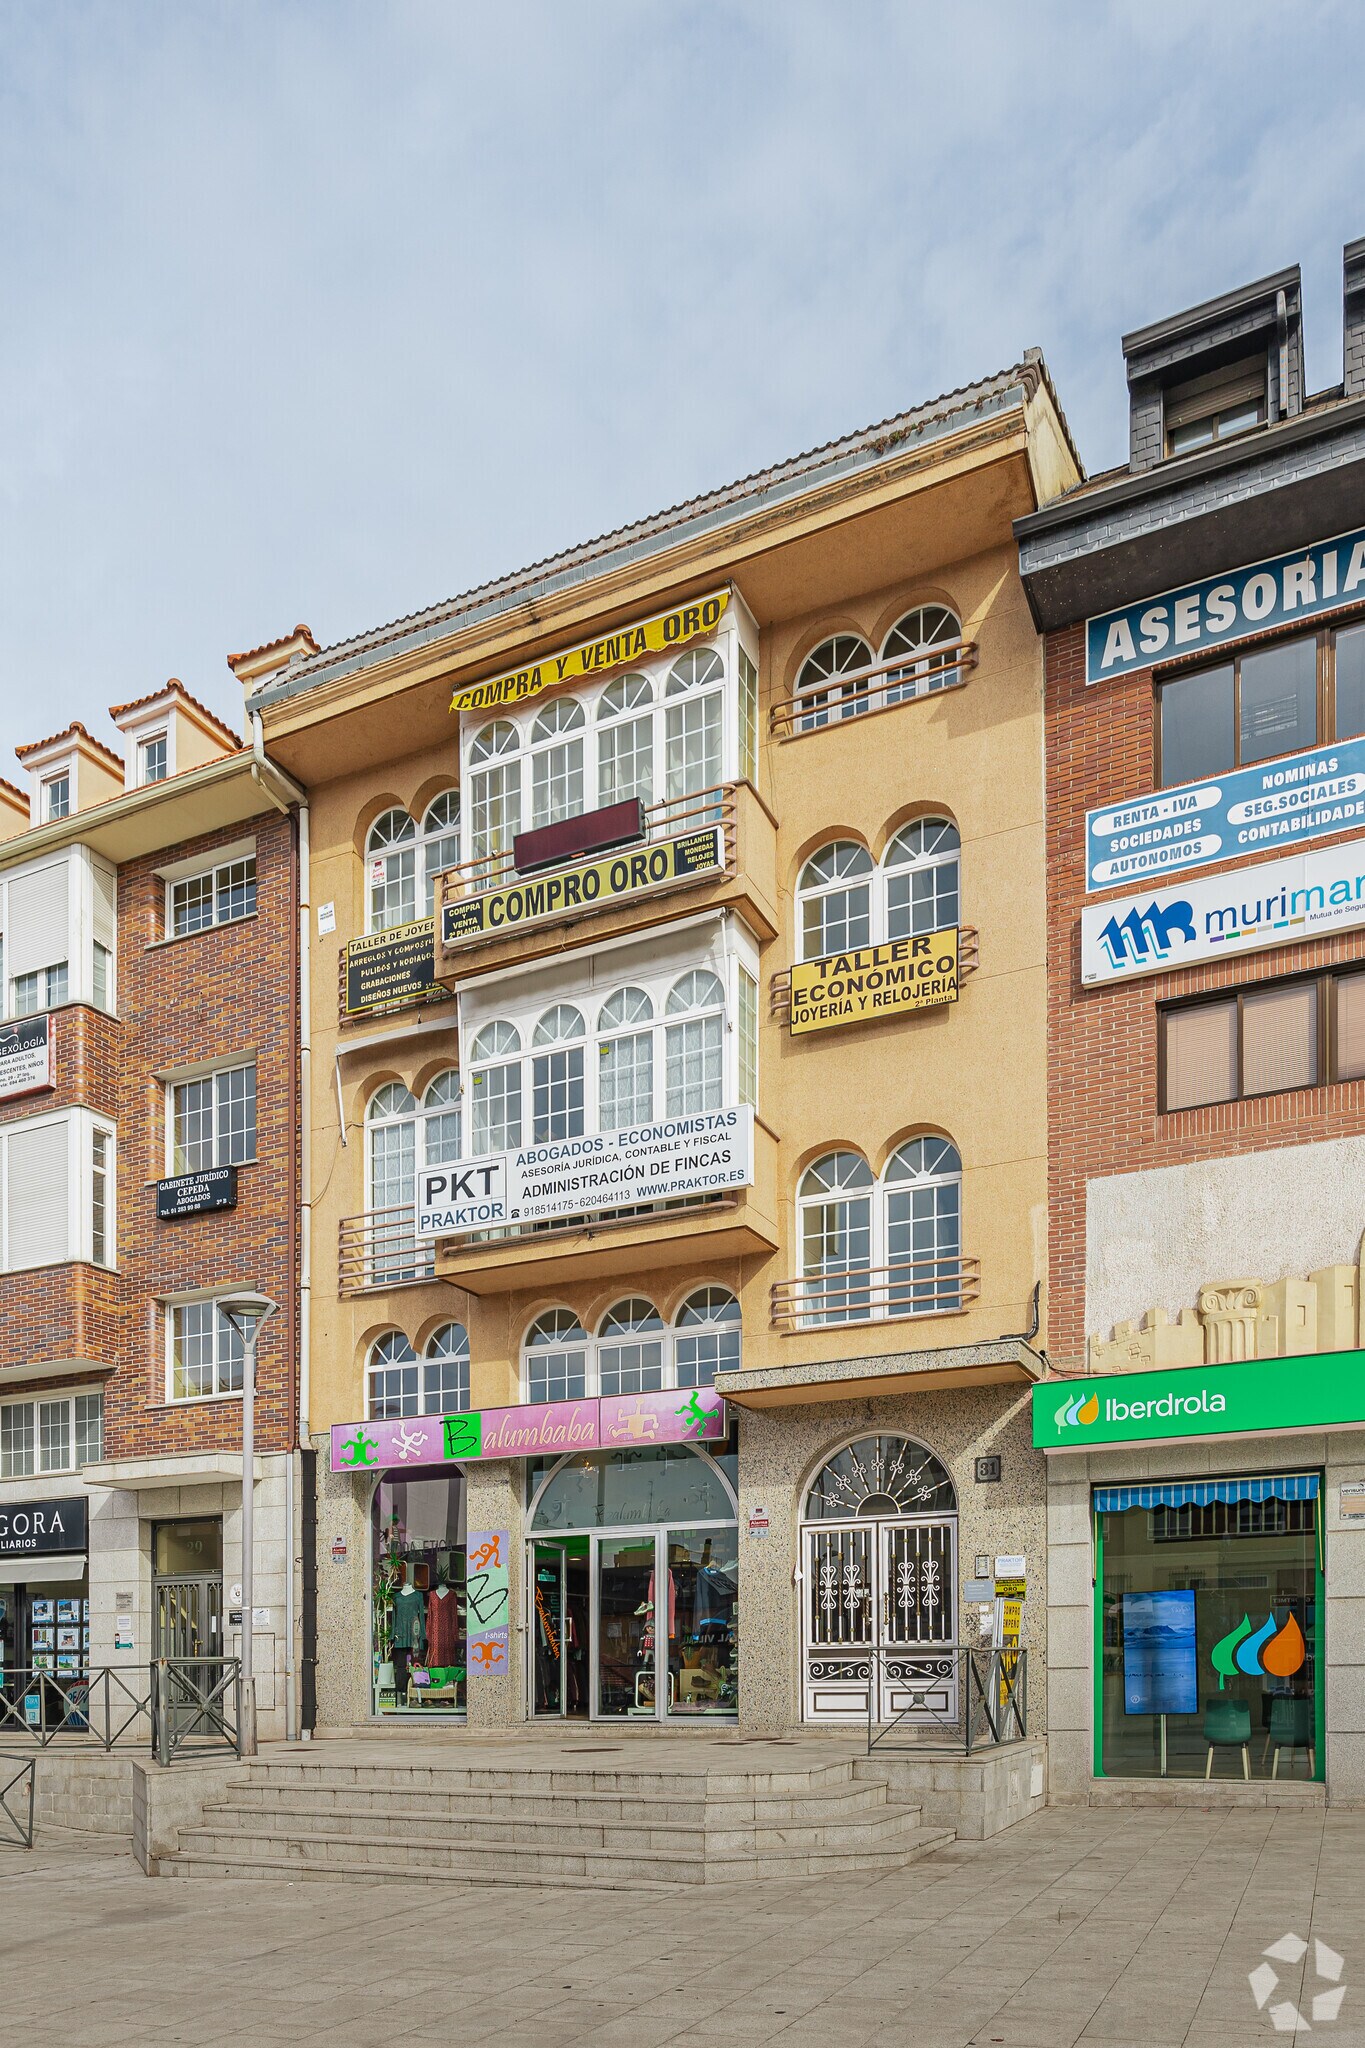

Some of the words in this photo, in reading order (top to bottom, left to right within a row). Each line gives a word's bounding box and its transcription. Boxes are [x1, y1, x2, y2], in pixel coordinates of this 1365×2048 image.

[1100, 540, 1365, 669] ASESORIA
[456, 667, 543, 708] COMPRA
[556, 656, 568, 679] Y
[581, 627, 647, 670] VENTA
[663, 599, 721, 642] ORO
[1262, 757, 1339, 790] NOMINAS
[1244, 778, 1357, 818] SEG.SOCIALES
[1113, 807, 1160, 829] RENTA
[1173, 795, 1198, 813] IVA
[1238, 800, 1365, 844] CONTABILIDADE
[677, 833, 714, 849] BRILLANTES
[684, 842, 714, 856] MONEDAS
[1110, 818, 1202, 853] SOCIEDADES
[687, 851, 714, 864] RELOJES
[695, 860, 714, 870] JOYAS
[1109, 841, 1202, 875] AUTONOMOS
[488, 869, 600, 927] COMPRO
[610, 849, 668, 893] ORO
[448, 902, 481, 917] COMPRA
[1205, 873, 1365, 934] murimar
[1309, 911, 1332, 920] Mutua
[452, 917, 478, 929] VENTA
[456, 925, 481, 936] PLANTA
[351, 936, 386, 952] TALLER
[389, 930, 402, 941] DE
[349, 951, 386, 968] ARREGLOS
[387, 949, 393, 957] Y
[360, 962, 391, 977] PULIDOS
[814, 937, 933, 979] TALLER
[360, 970, 411, 990] GRABACIONES
[360, 988, 391, 1004] DISEÑOS
[392, 981, 422, 995] NUEVOS
[793, 955, 955, 1007] ECONÓMICO
[792, 998, 853, 1026] JOYERÍA
[858, 996, 868, 1010] Y
[872, 975, 958, 1008] RELOJERÍA
[914, 1000, 924, 1008] 2ª
[925, 995, 953, 1005] Planta
[28, 1060, 44, 1069] NIÑOS
[516, 1138, 603, 1166] ABOGADOS
[618, 1112, 737, 1147] ECONOMISTAS
[521, 1162, 571, 1178] ASESORÍA
[573, 1154, 622, 1170] JURÍDICA,
[625, 1141, 680, 1159] CONTABLE
[684, 1139, 690, 1148] Y
[693, 1132, 731, 1146] FISCAL
[160, 1177, 194, 1191] GABINETE
[195, 1170, 229, 1184] JURÍDICO
[426, 1165, 499, 1205] PKT
[522, 1164, 645, 1199] ADMINISTRACIÓN
[650, 1160, 670, 1176] DE
[675, 1150, 731, 1171] FINCAS
[636, 1169, 745, 1197] WWW.PRAKTOR.ES
[176, 1192, 211, 1205] ABOGADOS
[177, 1183, 210, 1197] CEPEDA
[421, 1203, 503, 1230] PRAKTOR
[1106, 1390, 1226, 1421] Iberdrola
[980, 1462, 996, 1476] 31
